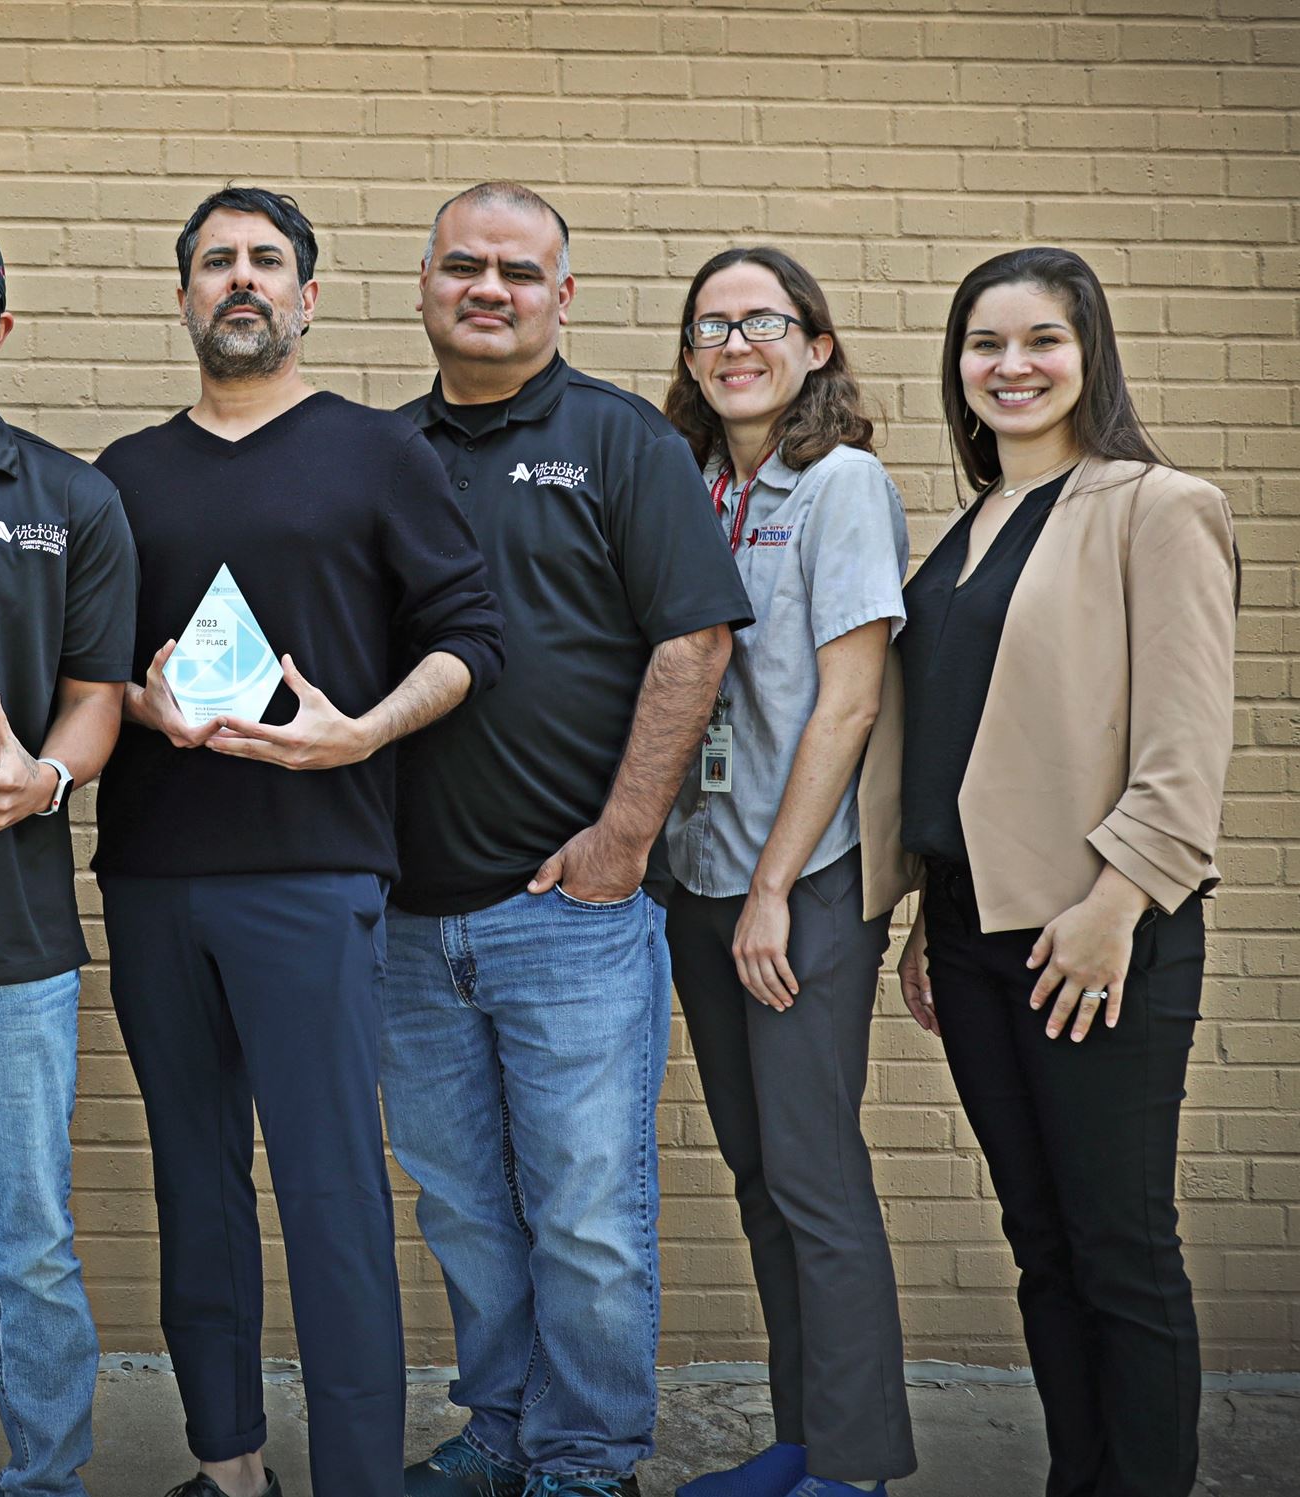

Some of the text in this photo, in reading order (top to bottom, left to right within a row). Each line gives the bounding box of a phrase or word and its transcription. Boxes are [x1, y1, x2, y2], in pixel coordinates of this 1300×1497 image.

[534, 466, 585, 482] VICTORIA
[38, 523, 58, 531] CITY
[16, 528, 67, 547] VICTORIA
[196, 619, 217, 627] 2023
